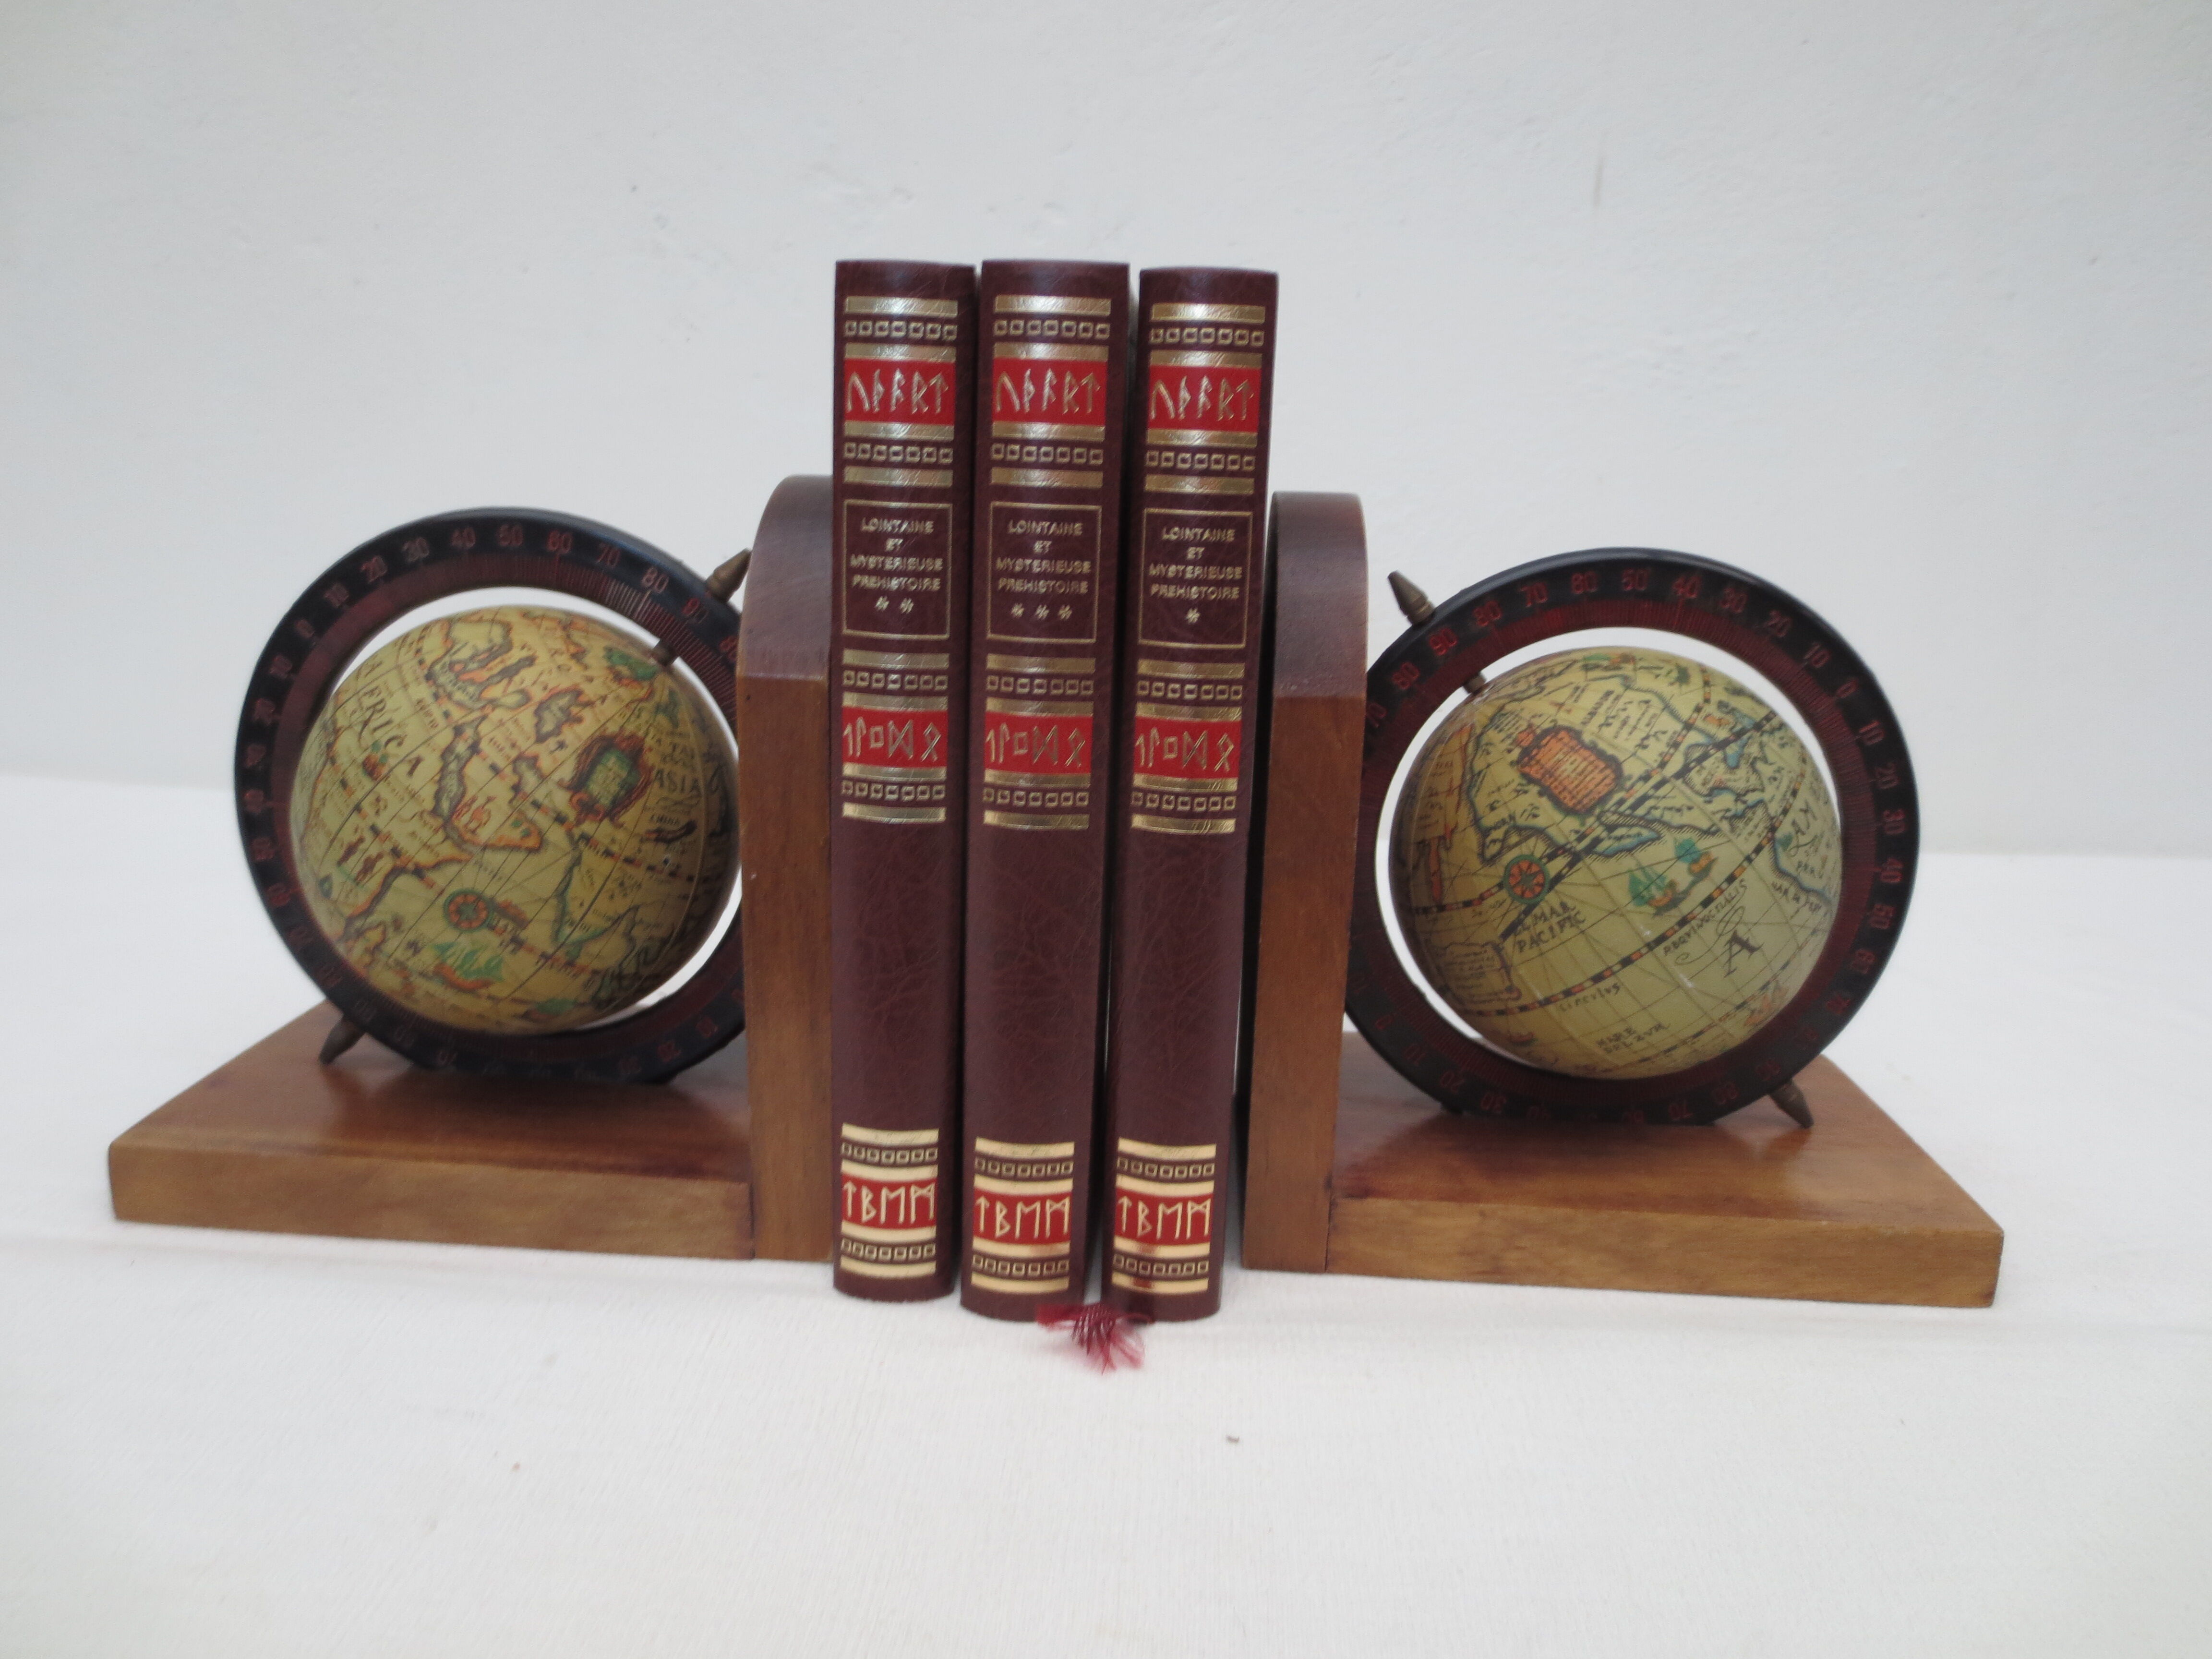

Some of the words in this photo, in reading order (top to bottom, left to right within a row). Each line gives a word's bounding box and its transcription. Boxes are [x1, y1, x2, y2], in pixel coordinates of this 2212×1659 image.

[861, 517, 934, 535] LOINTAINE
[1008, 519, 1083, 537] LOINTAINE
[1162, 527, 1236, 542] LOINTAINE
[886, 538, 903, 552] ET
[1034, 541, 1052, 554] ET
[1186, 547, 1205, 560] ET
[849, 554, 943, 572] MYSTERIEUSE
[996, 557, 1091, 574] MYSTERIEUSE
[1149, 563, 1242, 580] MYSTERIEUSE
[641, 567, 669, 593] 80
[852, 574, 941, 592] PREHISTOIRE
[998, 577, 1089, 595] PREHISTOIRE
[1150, 583, 1240, 600] PREHISTOIRE
[1520, 582, 1548, 607] 70
[1803, 644, 1831, 669] 10
[1859, 721, 1886, 745] 10
[1880, 856, 1902, 884] 40
